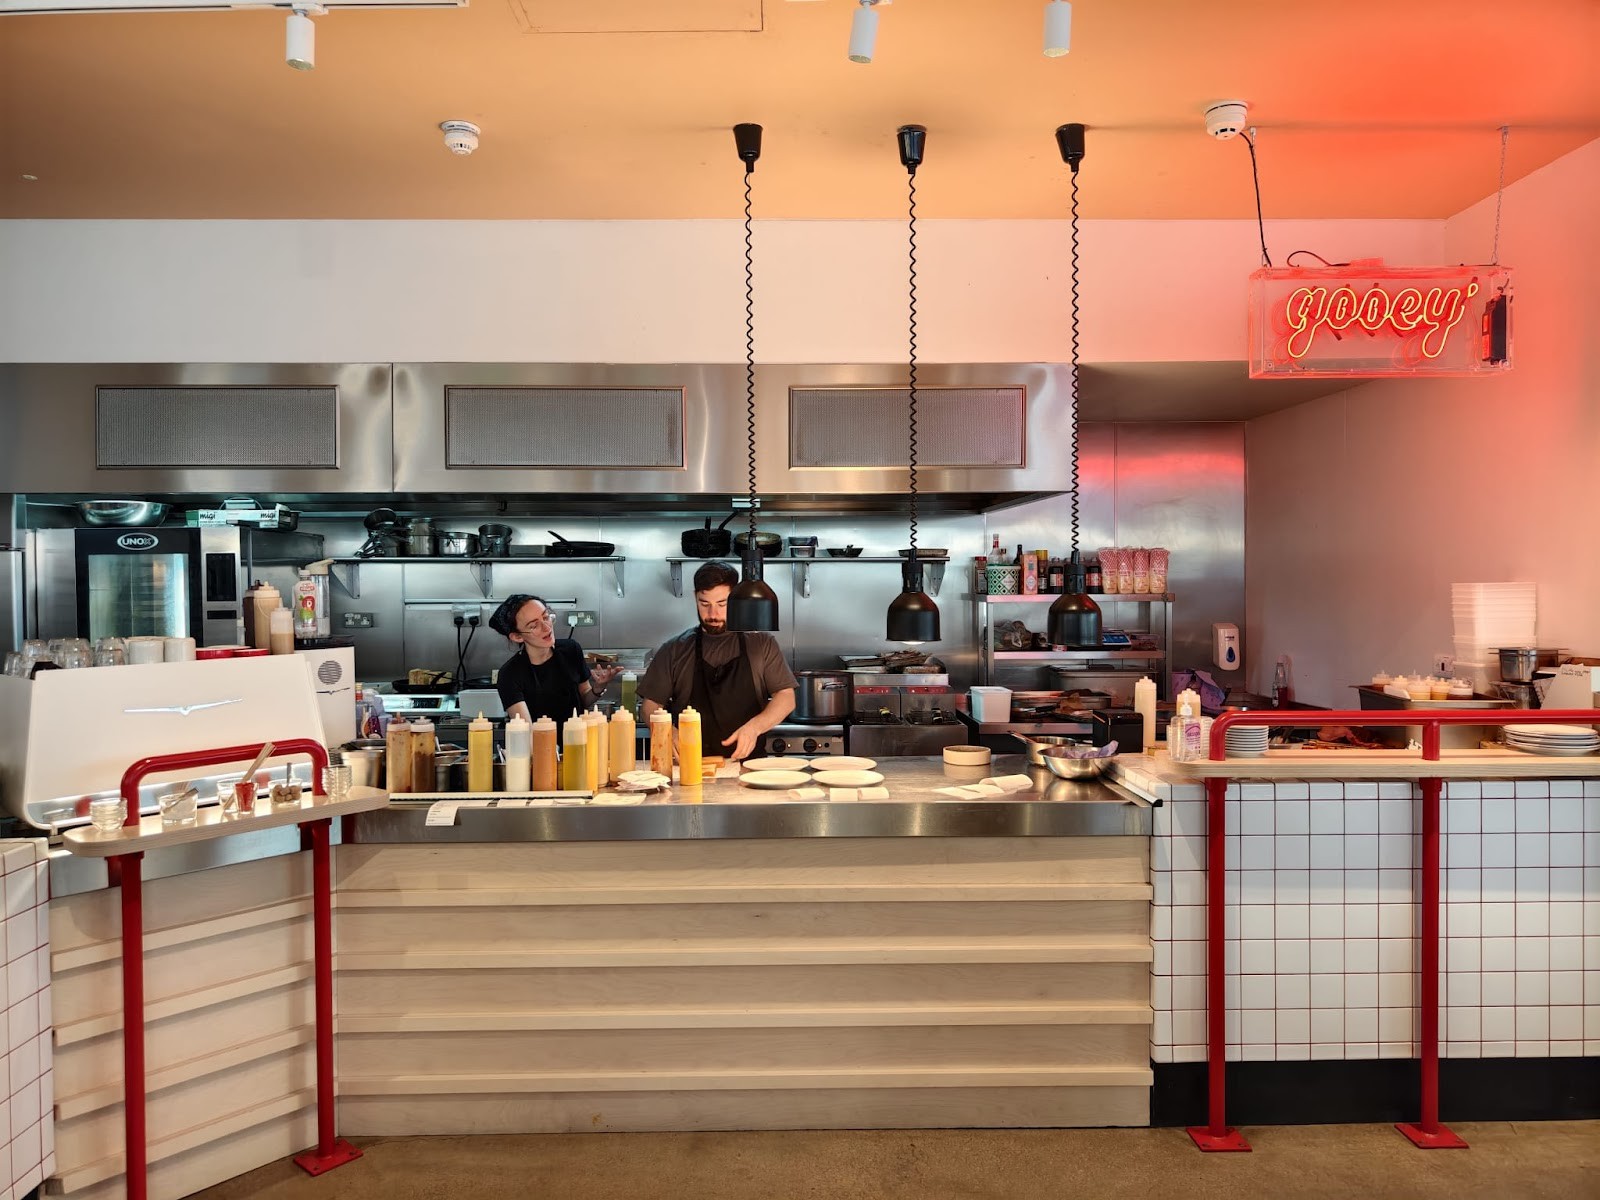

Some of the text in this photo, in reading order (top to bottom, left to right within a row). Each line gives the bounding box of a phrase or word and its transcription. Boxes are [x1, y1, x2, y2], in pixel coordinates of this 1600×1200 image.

[1287, 287, 1466, 358] gooey
[200, 511, 216, 520] migi
[260, 511, 276, 520] migi
[122, 537, 152, 546] UNOX
